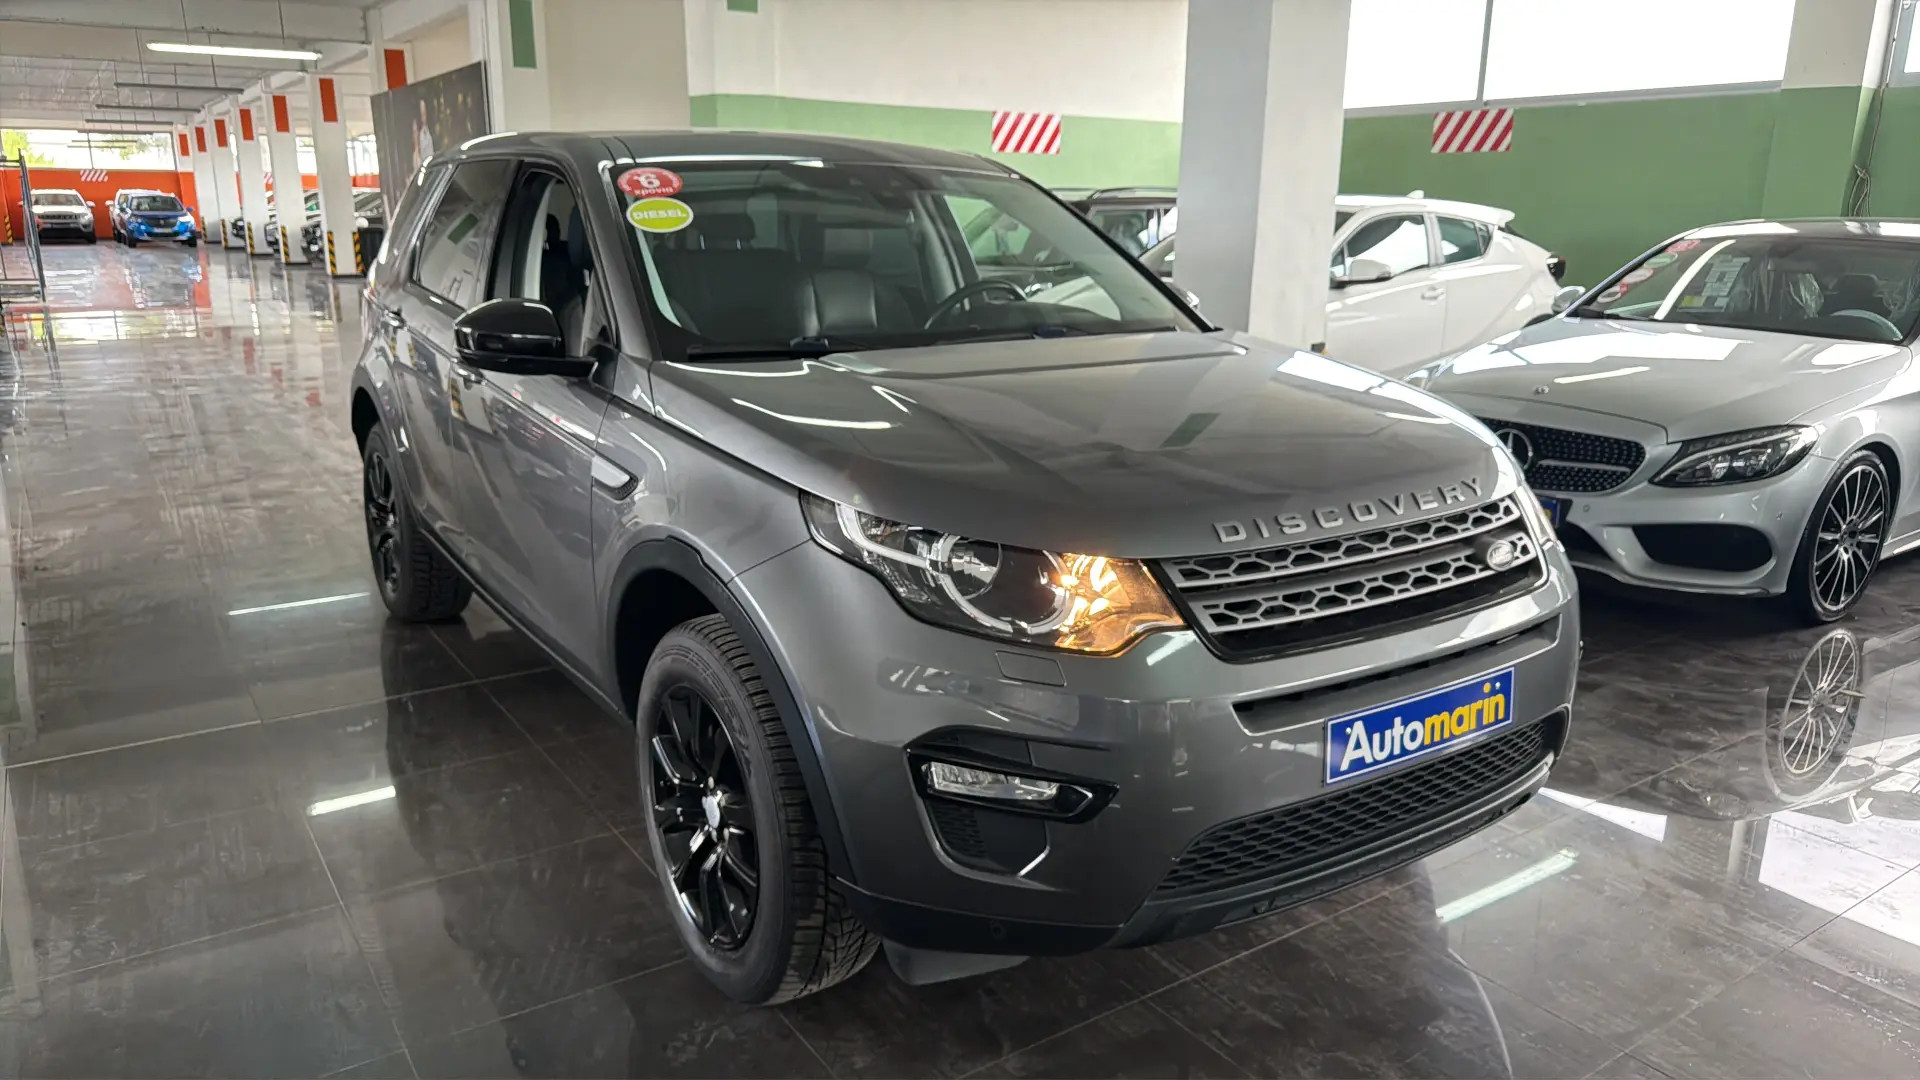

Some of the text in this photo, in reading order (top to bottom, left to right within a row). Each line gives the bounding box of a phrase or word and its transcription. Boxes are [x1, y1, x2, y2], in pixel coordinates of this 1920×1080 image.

[632, 208, 687, 220] DIESEL
[1213, 476, 1483, 543] DISCOVERY
[1340, 682, 1505, 772] Automarin
